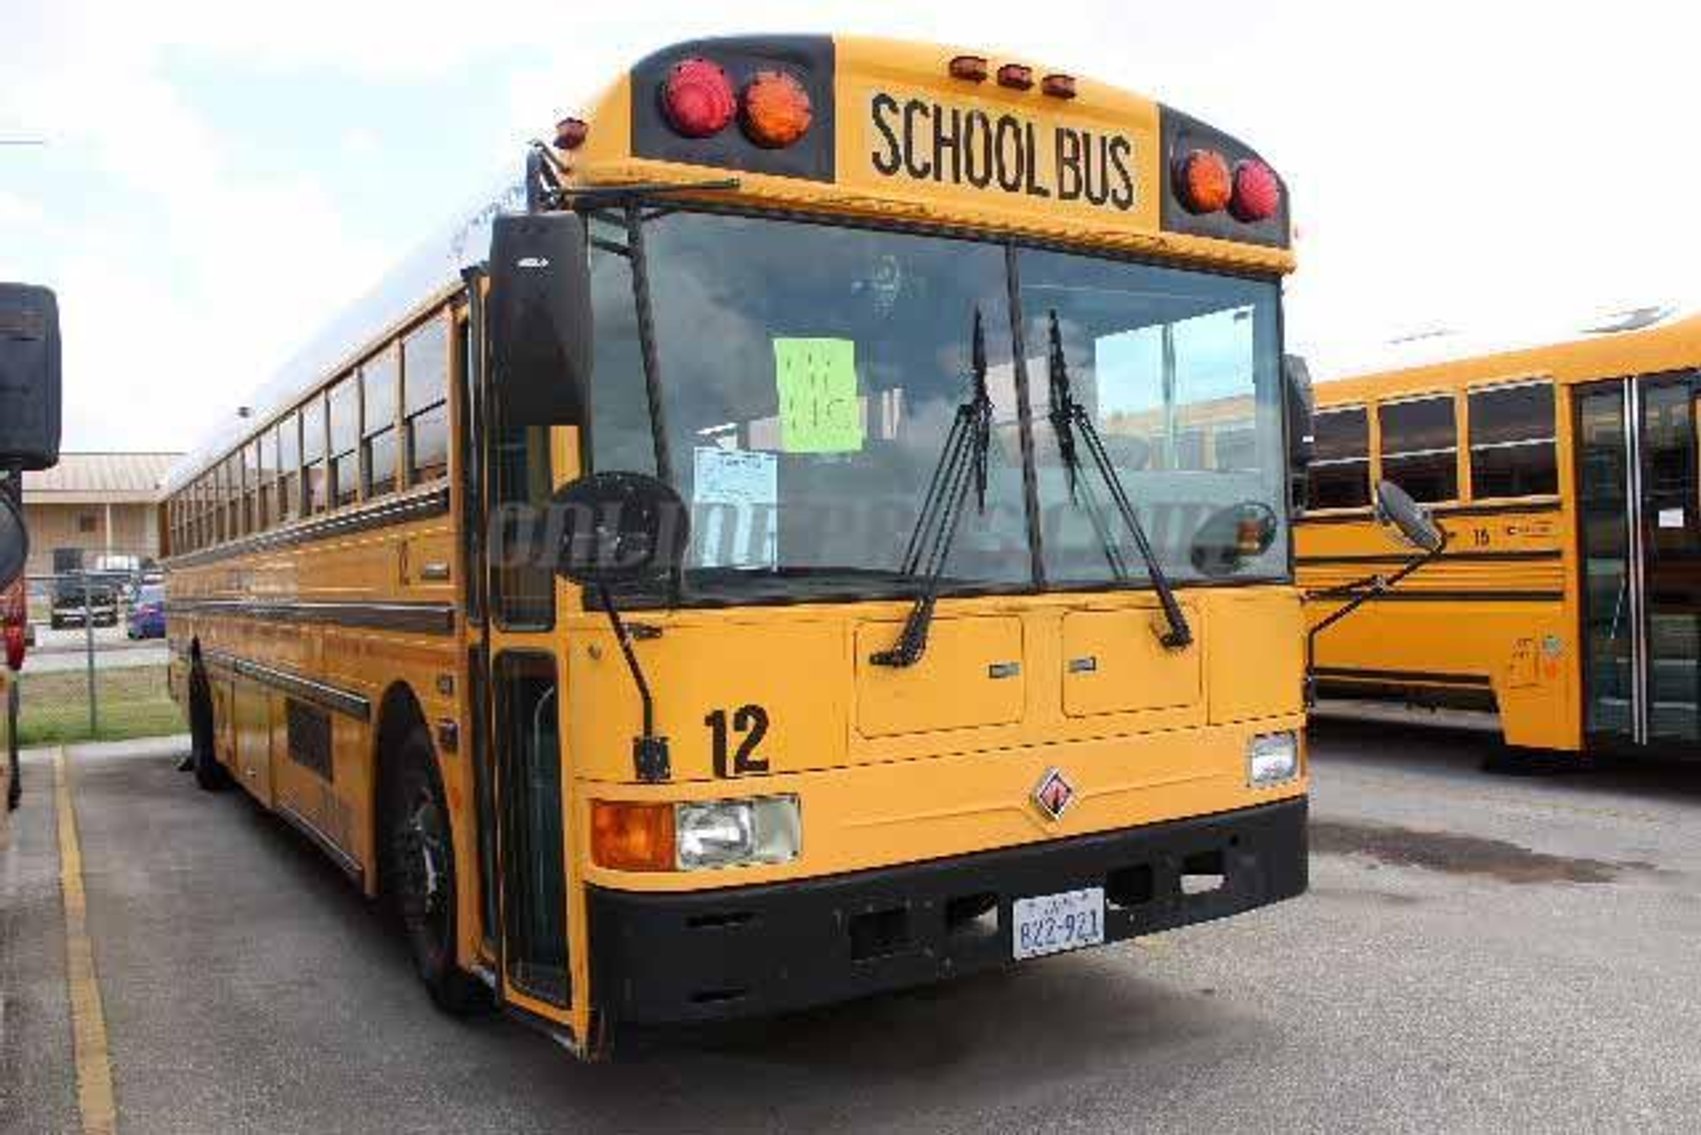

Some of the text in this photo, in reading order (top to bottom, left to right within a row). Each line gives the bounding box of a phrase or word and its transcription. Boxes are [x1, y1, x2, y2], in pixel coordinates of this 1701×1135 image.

[872, 93, 1134, 212] SCHOOL BUS
[704, 704, 769, 778] 12
